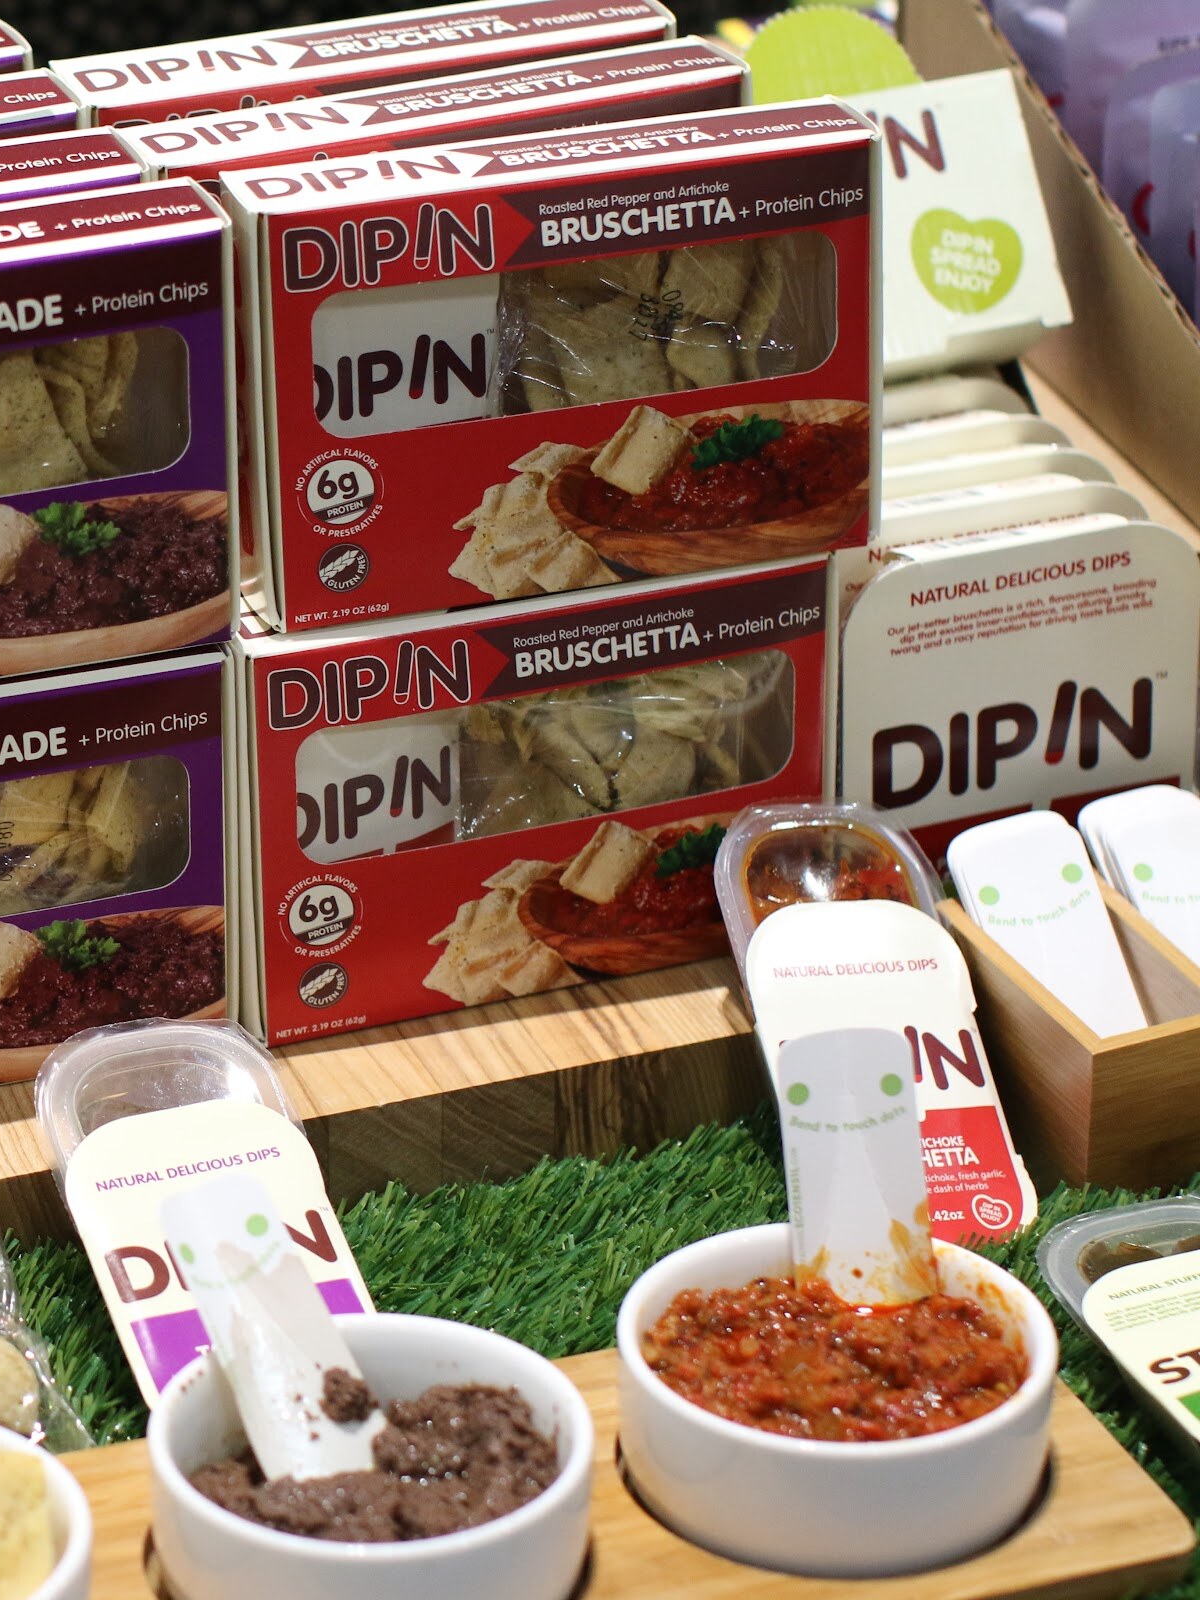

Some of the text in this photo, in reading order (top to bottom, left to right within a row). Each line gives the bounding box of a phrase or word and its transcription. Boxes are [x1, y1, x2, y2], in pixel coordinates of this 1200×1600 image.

[312, 20, 518, 58] BRUSCHETTA
[533, 10, 596, 28] Protein
[599, 3, 651, 19] Chips
[4, 88, 58, 105] Chips
[384, 73, 591, 115] BRUSCHETTA
[610, 63, 670, 80] Protein
[674, 54, 726, 70] Chips
[67, 147, 121, 163] Chips
[499, 130, 717, 167] BRUSCHETTA
[734, 122, 800, 138] Protein
[804, 116, 858, 130] Chips
[539, 181, 729, 216] Roasted Red Pepper and Artichoke
[72, 209, 142, 229] Protein
[145, 202, 201, 217] Chips
[540, 196, 736, 247] BRUSCHETTA
[755, 194, 814, 217] Protein
[818, 186, 864, 207] Chips
[92, 290, 153, 314] Protein
[159, 281, 208, 303] Chips
[343, 448, 379, 470] FLAVORS
[317, 469, 360, 500] 6g
[327, 500, 364, 518] PROTEIN
[910, 551, 1131, 608] NATURAL DELICIOUS DIPS
[295, 602, 389, 623] NET WT. 2.19 OZ (62g)
[513, 607, 695, 648] Roasted Red Pepper and Artichoke
[514, 622, 701, 679] BRUSCHETTA
[719, 616, 774, 640] Protein
[778, 606, 820, 627] Chips
[96, 720, 155, 744] Protein
[161, 712, 208, 733] Chips
[324, 874, 358, 893] FLAVORS
[298, 894, 339, 922] 6g
[308, 922, 344, 939] PROTEIN
[773, 958, 938, 979] NATURAL DELICIOUS DIPS
[276, 1029, 292, 1039] NET
[294, 1026, 310, 1036] WT.
[311, 1022, 329, 1033] 2.19
[331, 1020, 344, 1029] OZ
[95, 1147, 281, 1192] NATURAL DELICIOUS DIPS
[958, 1172, 980, 1182] fresh
[933, 1185, 954, 1194] dash
[965, 1183, 989, 1192] herbs
